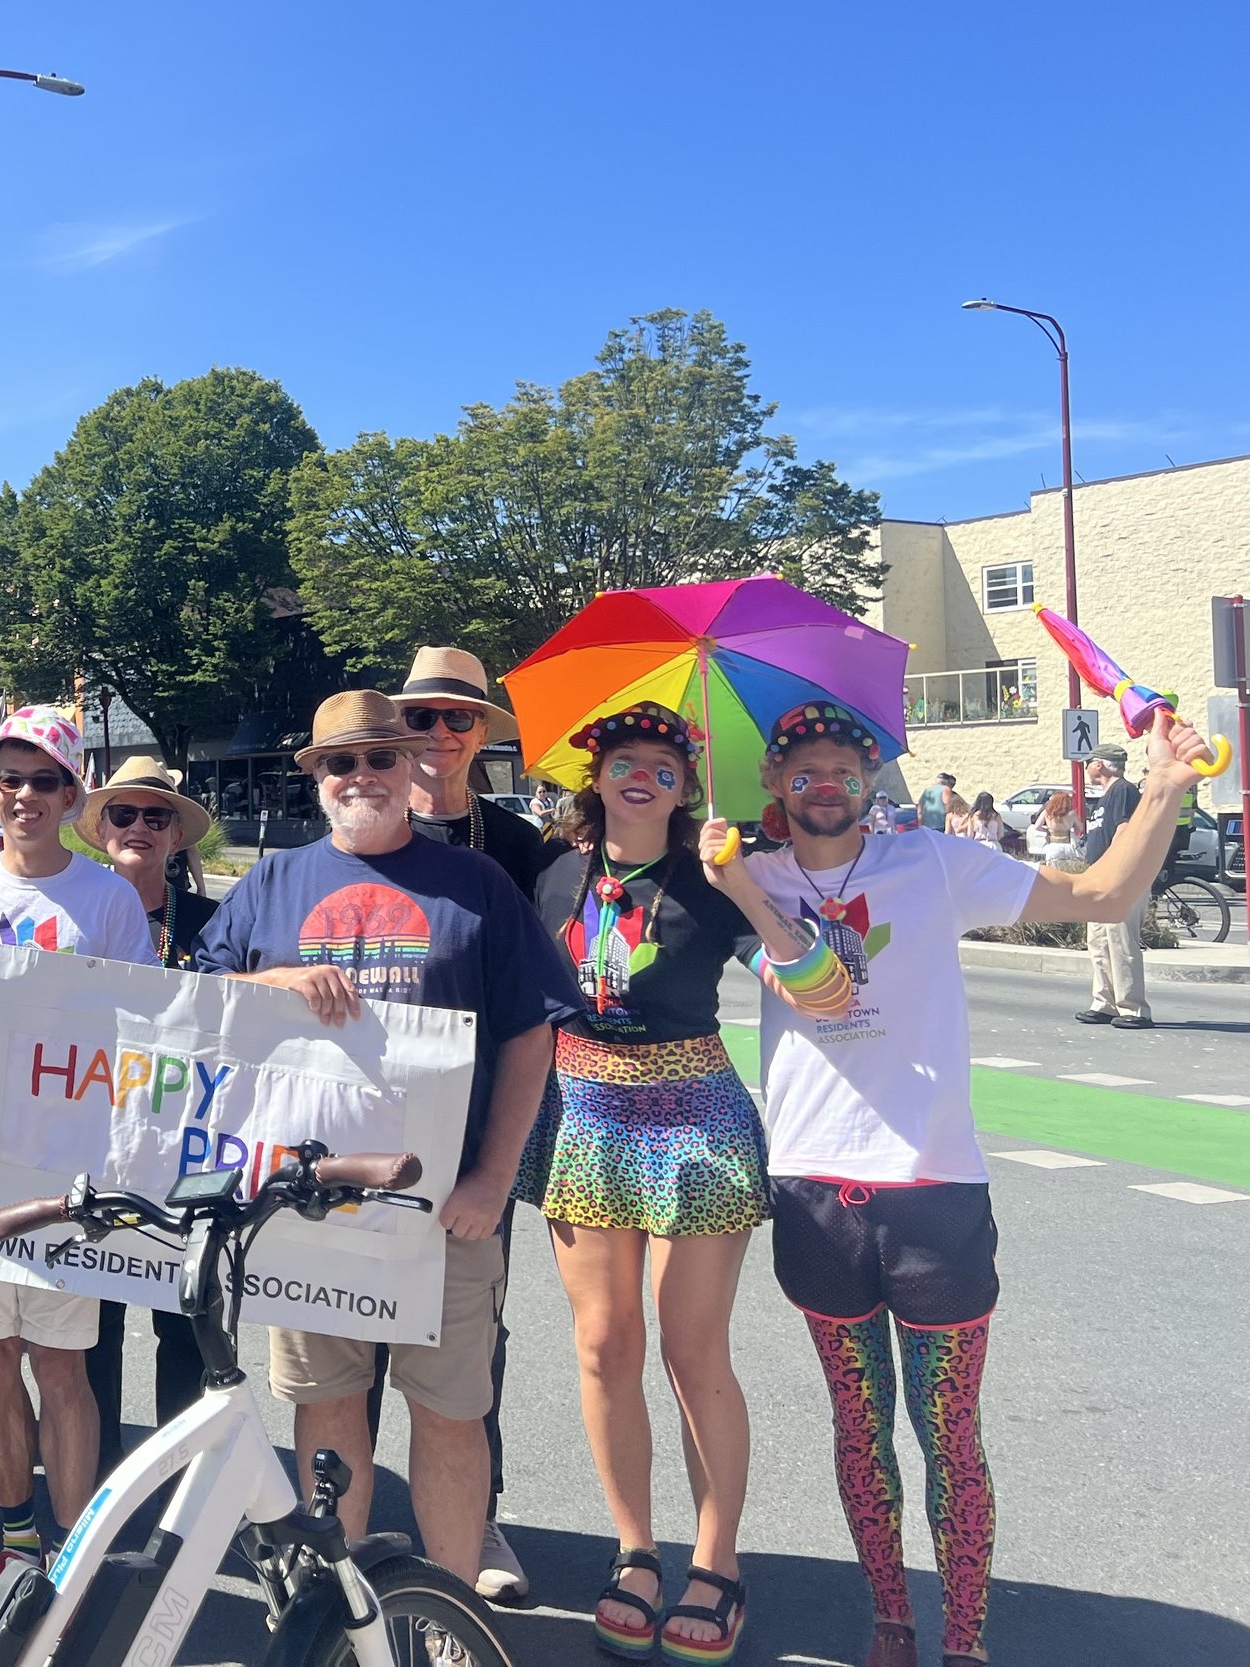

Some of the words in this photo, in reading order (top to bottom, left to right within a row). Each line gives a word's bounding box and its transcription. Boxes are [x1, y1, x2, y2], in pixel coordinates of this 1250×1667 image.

[317, 902, 411, 938] 1969
[816, 1019, 870, 1033] RESIDENTS
[818, 1029, 886, 1044] ASSOCIATION
[31, 1043, 230, 1120] HAPPY
[45, 1243, 181, 1284] RESIDENT
[225, 1271, 398, 1320] SSOCIATION
[66, 1508, 95, 1554] Milano
